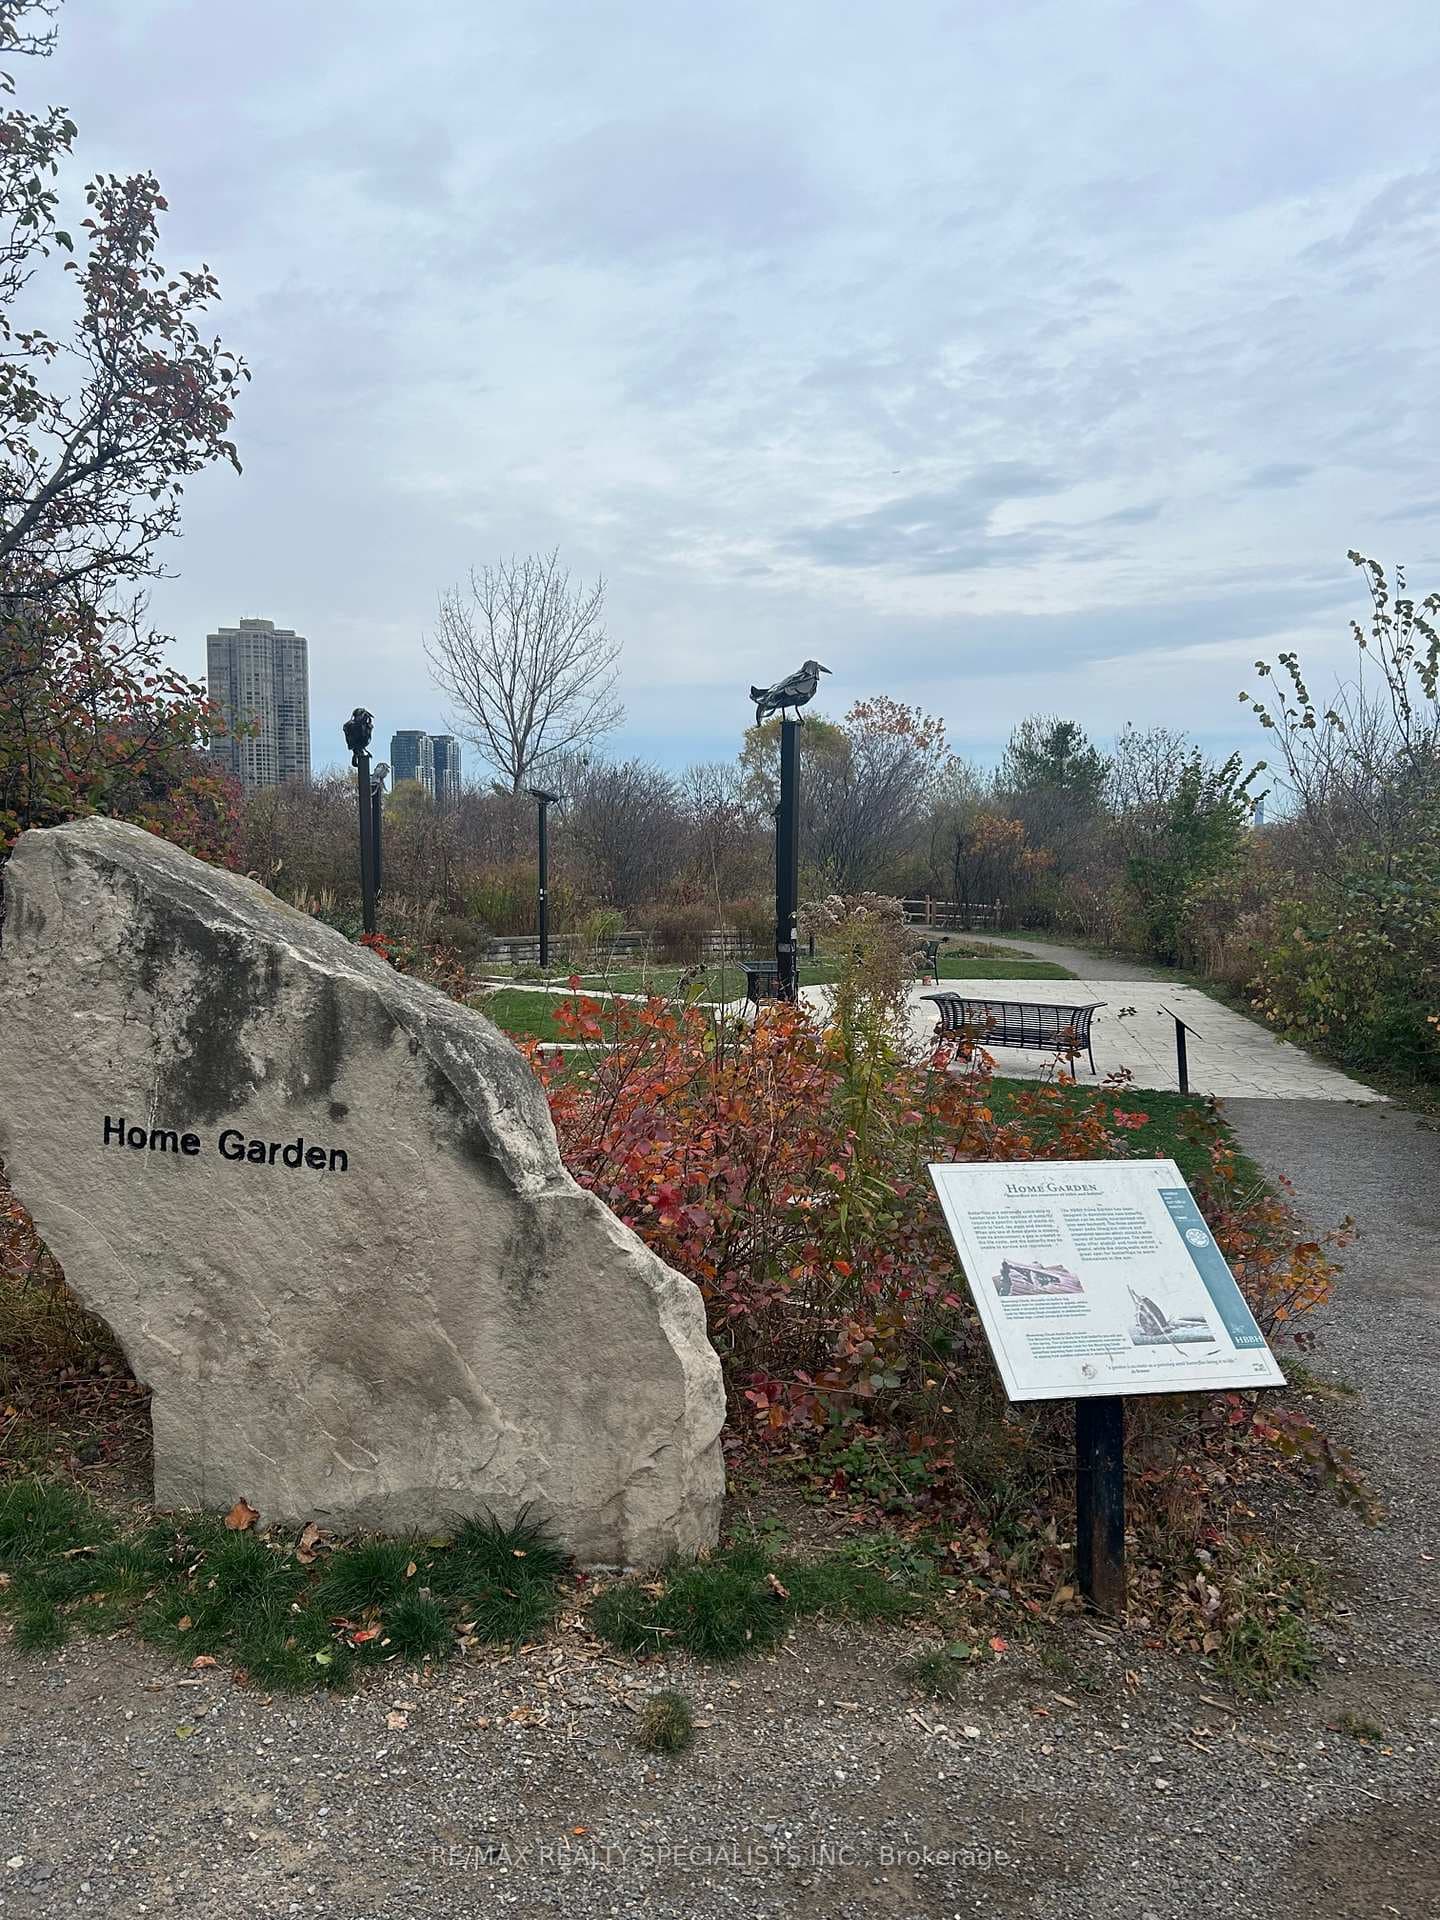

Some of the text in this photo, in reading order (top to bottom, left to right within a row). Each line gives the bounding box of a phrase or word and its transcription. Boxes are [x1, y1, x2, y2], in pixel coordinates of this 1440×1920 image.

[103, 1115, 349, 1172] Home Garden
[1046, 1182, 1098, 1192] GARDEN
